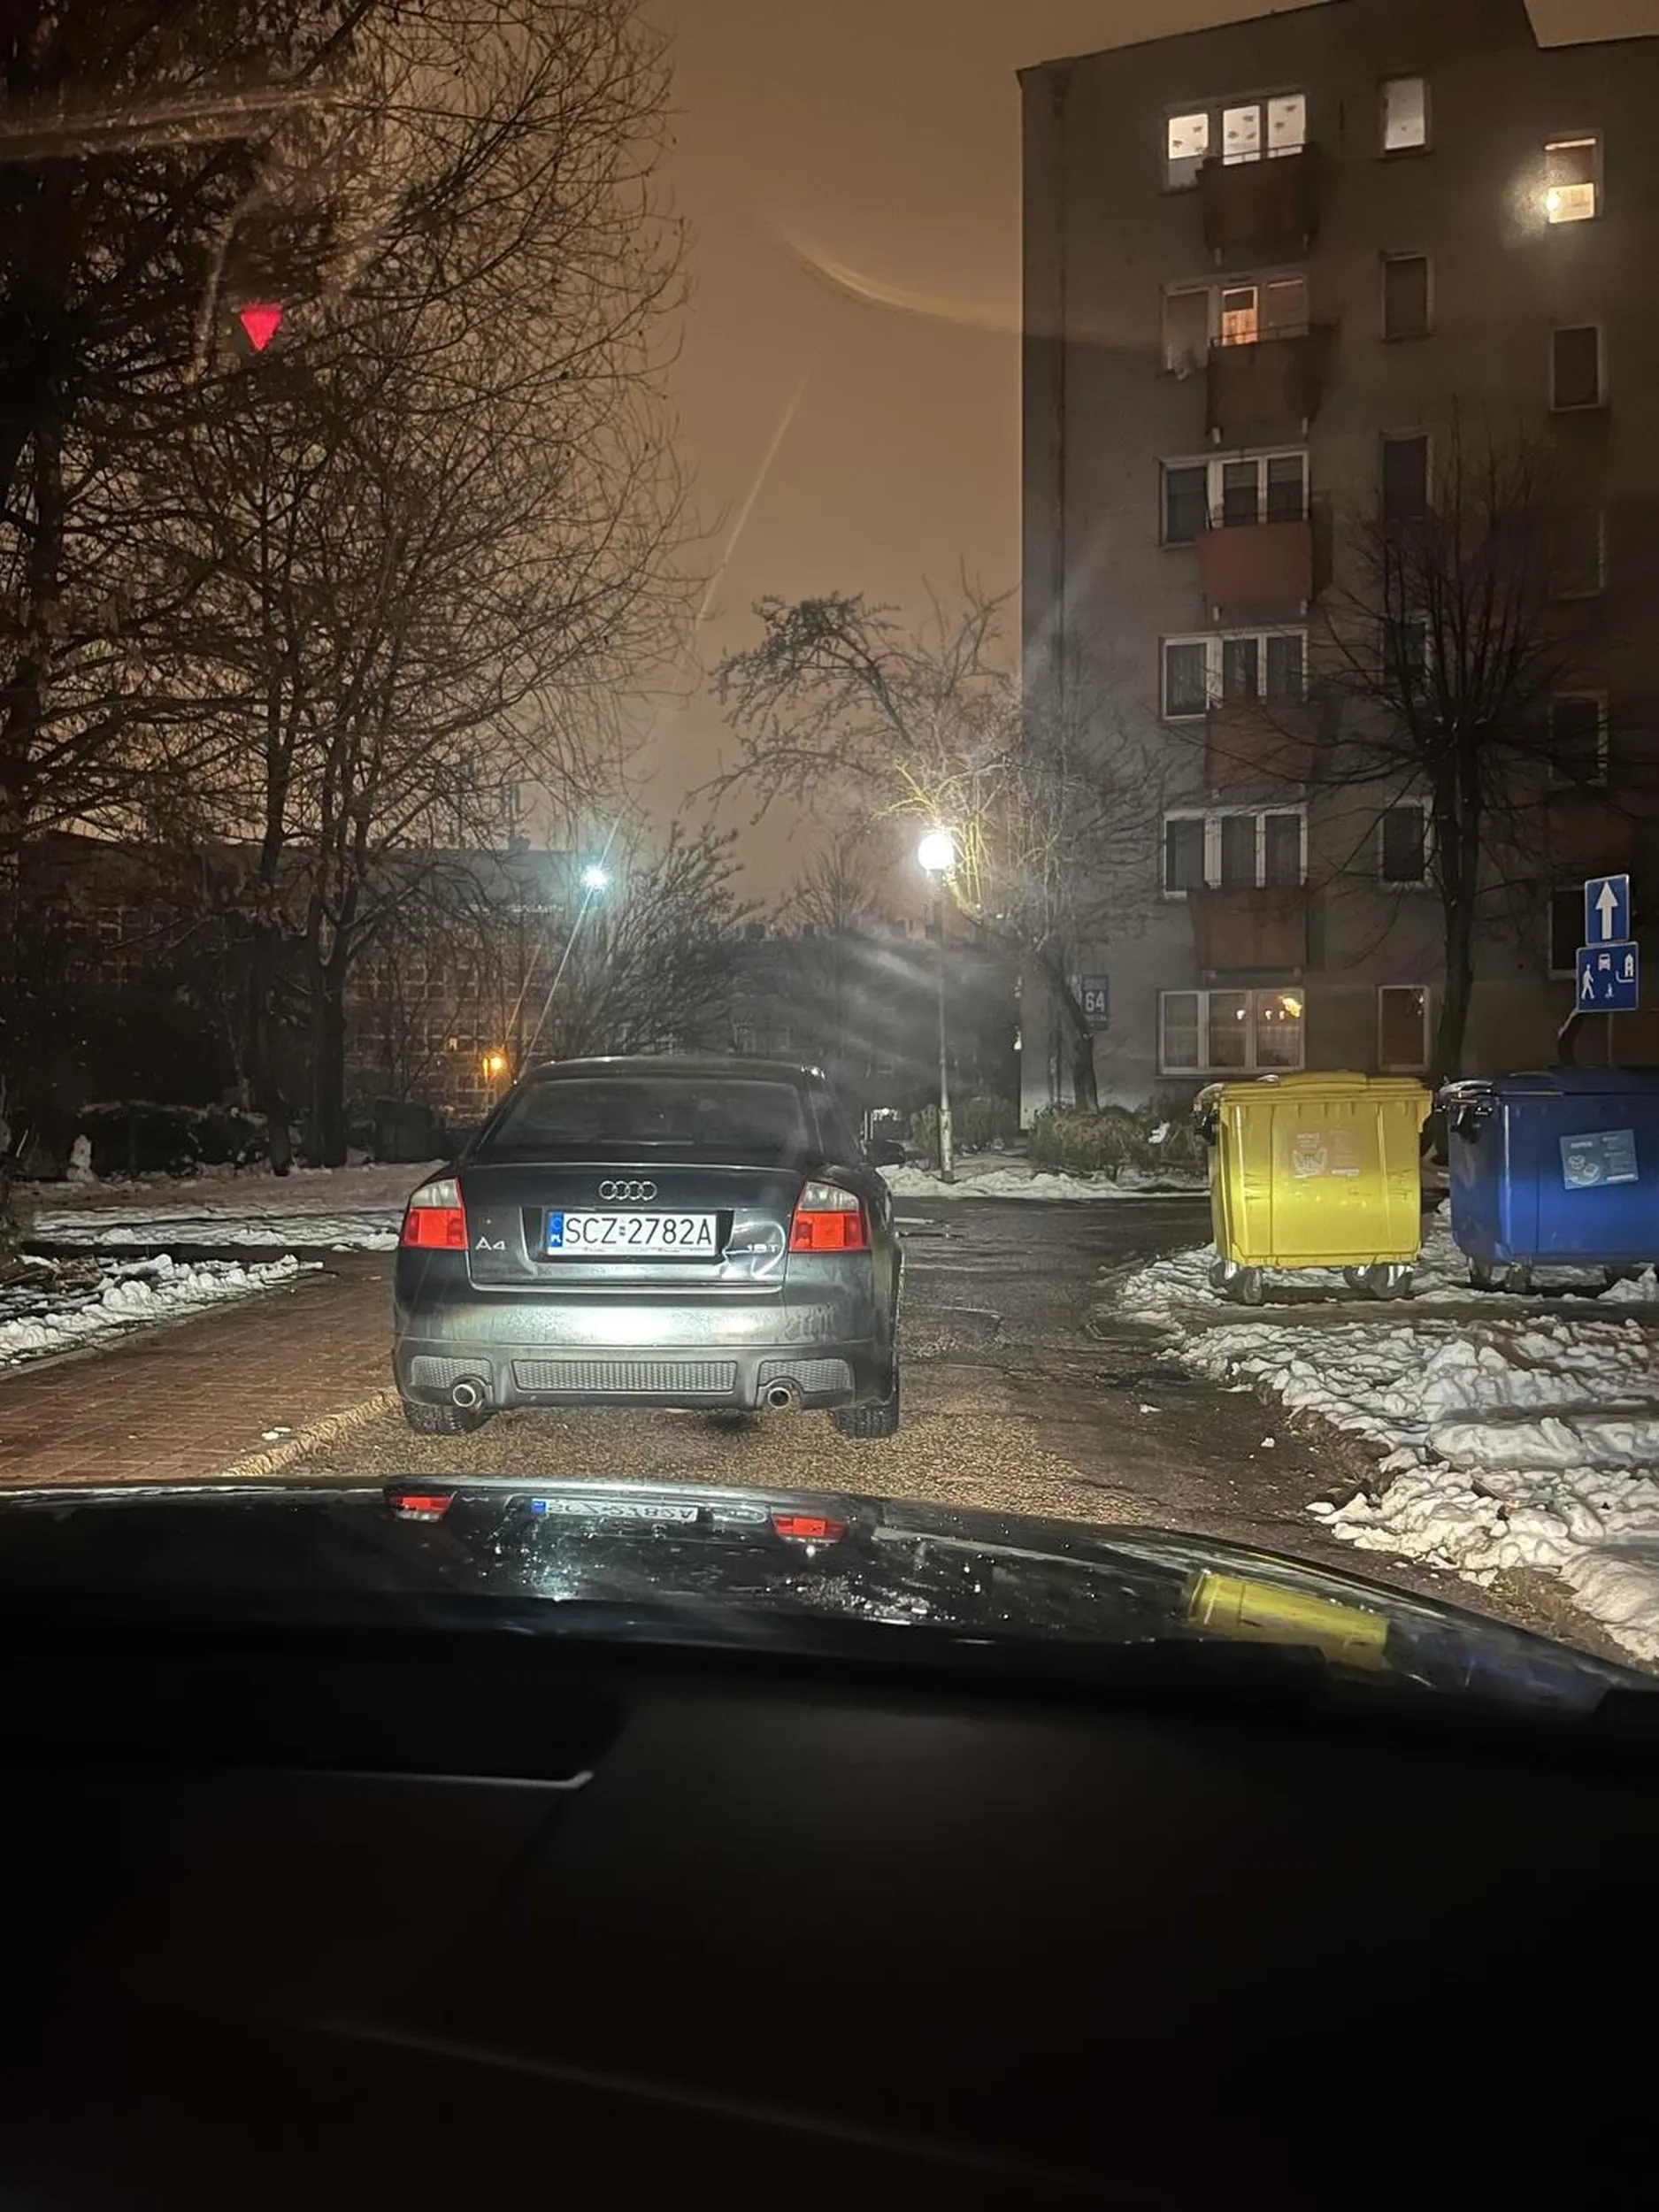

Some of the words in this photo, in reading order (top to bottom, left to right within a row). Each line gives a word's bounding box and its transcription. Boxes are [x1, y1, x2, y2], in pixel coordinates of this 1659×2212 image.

[1086, 992, 1104, 1012] 64
[566, 1217, 618, 1245] SCZ
[627, 1217, 712, 1246] 2782A
[475, 1236, 505, 1250] A4
